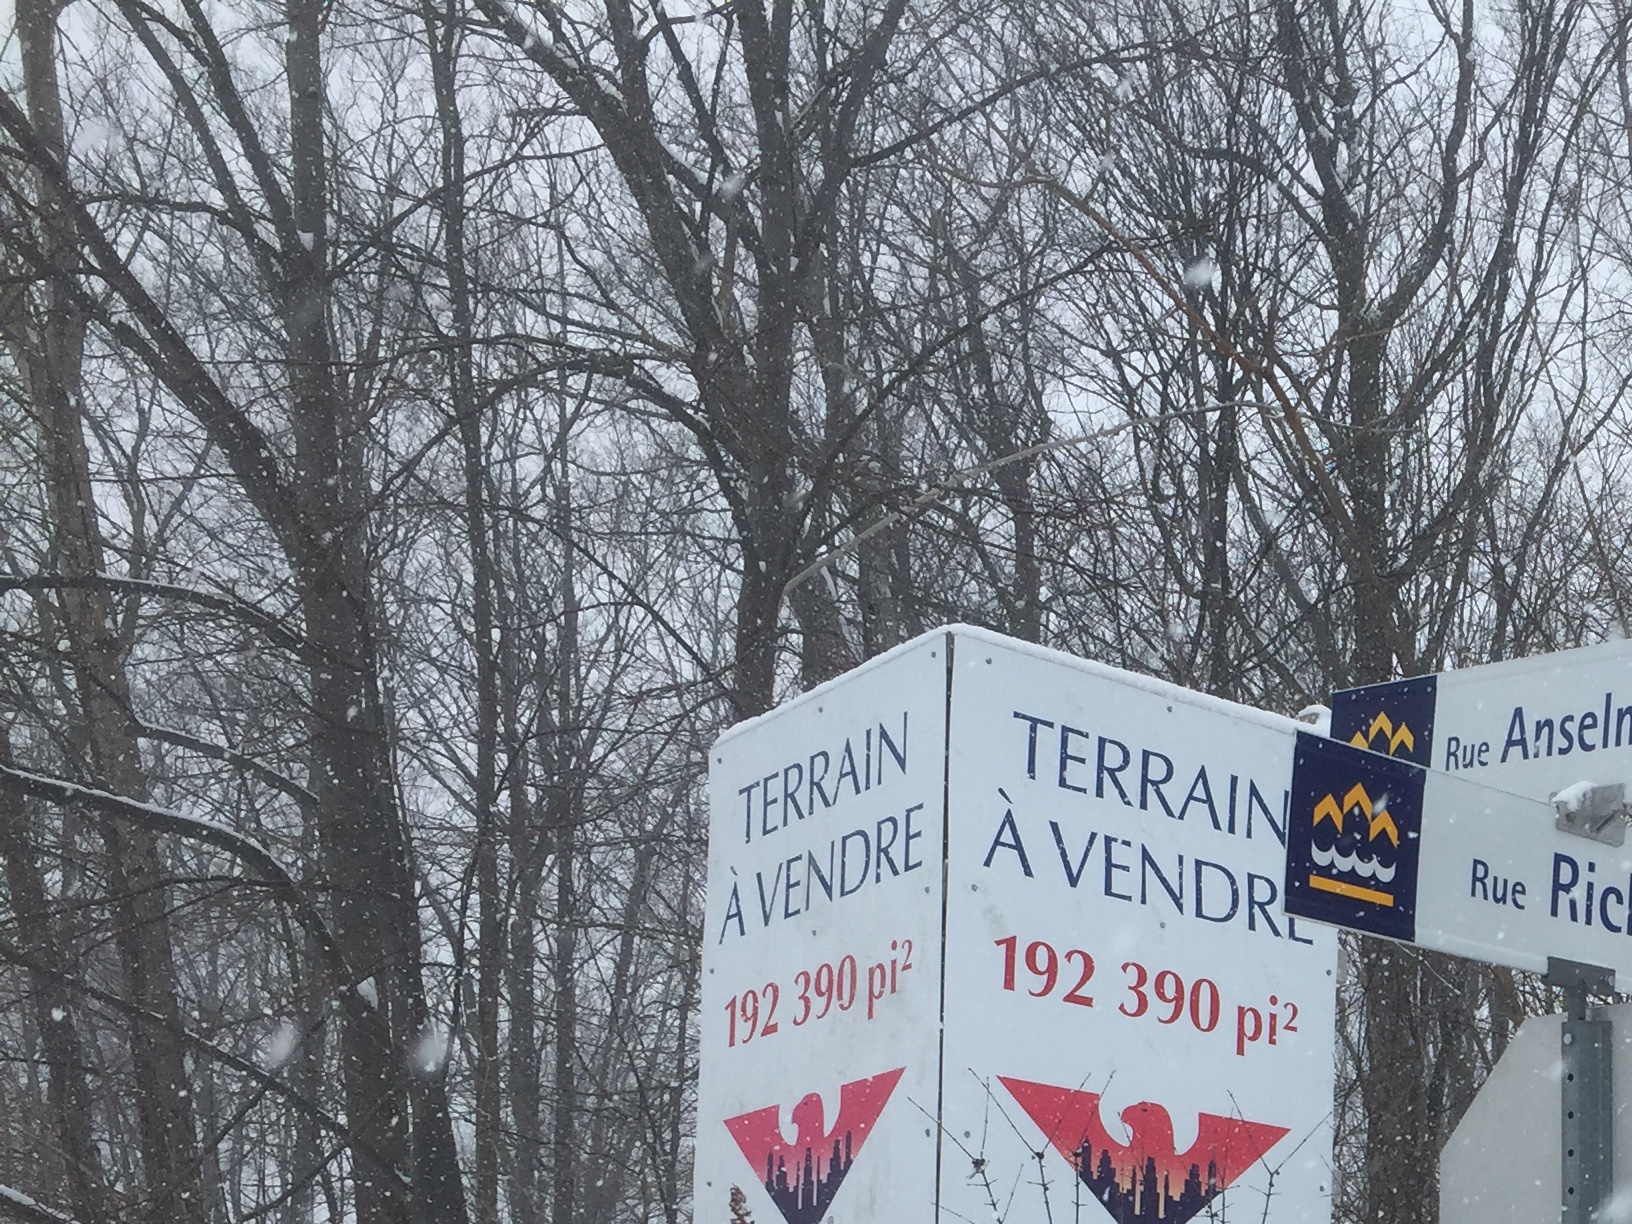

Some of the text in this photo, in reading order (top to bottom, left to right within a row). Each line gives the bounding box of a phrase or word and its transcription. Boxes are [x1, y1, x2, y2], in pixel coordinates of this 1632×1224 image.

[738, 710, 908, 844] TERRAIN
[1012, 710, 1288, 850] TERRAIN
[1445, 735, 1490, 772] Rue
[718, 802, 924, 945] À VENDRE
[983, 787, 1034, 879] À
[1470, 857, 1527, 911] Rue
[723, 980, 780, 1049] 192
[792, 953, 858, 1027] 390
[994, 935, 1096, 1009] 192
[1118, 961, 1221, 1034] 390
